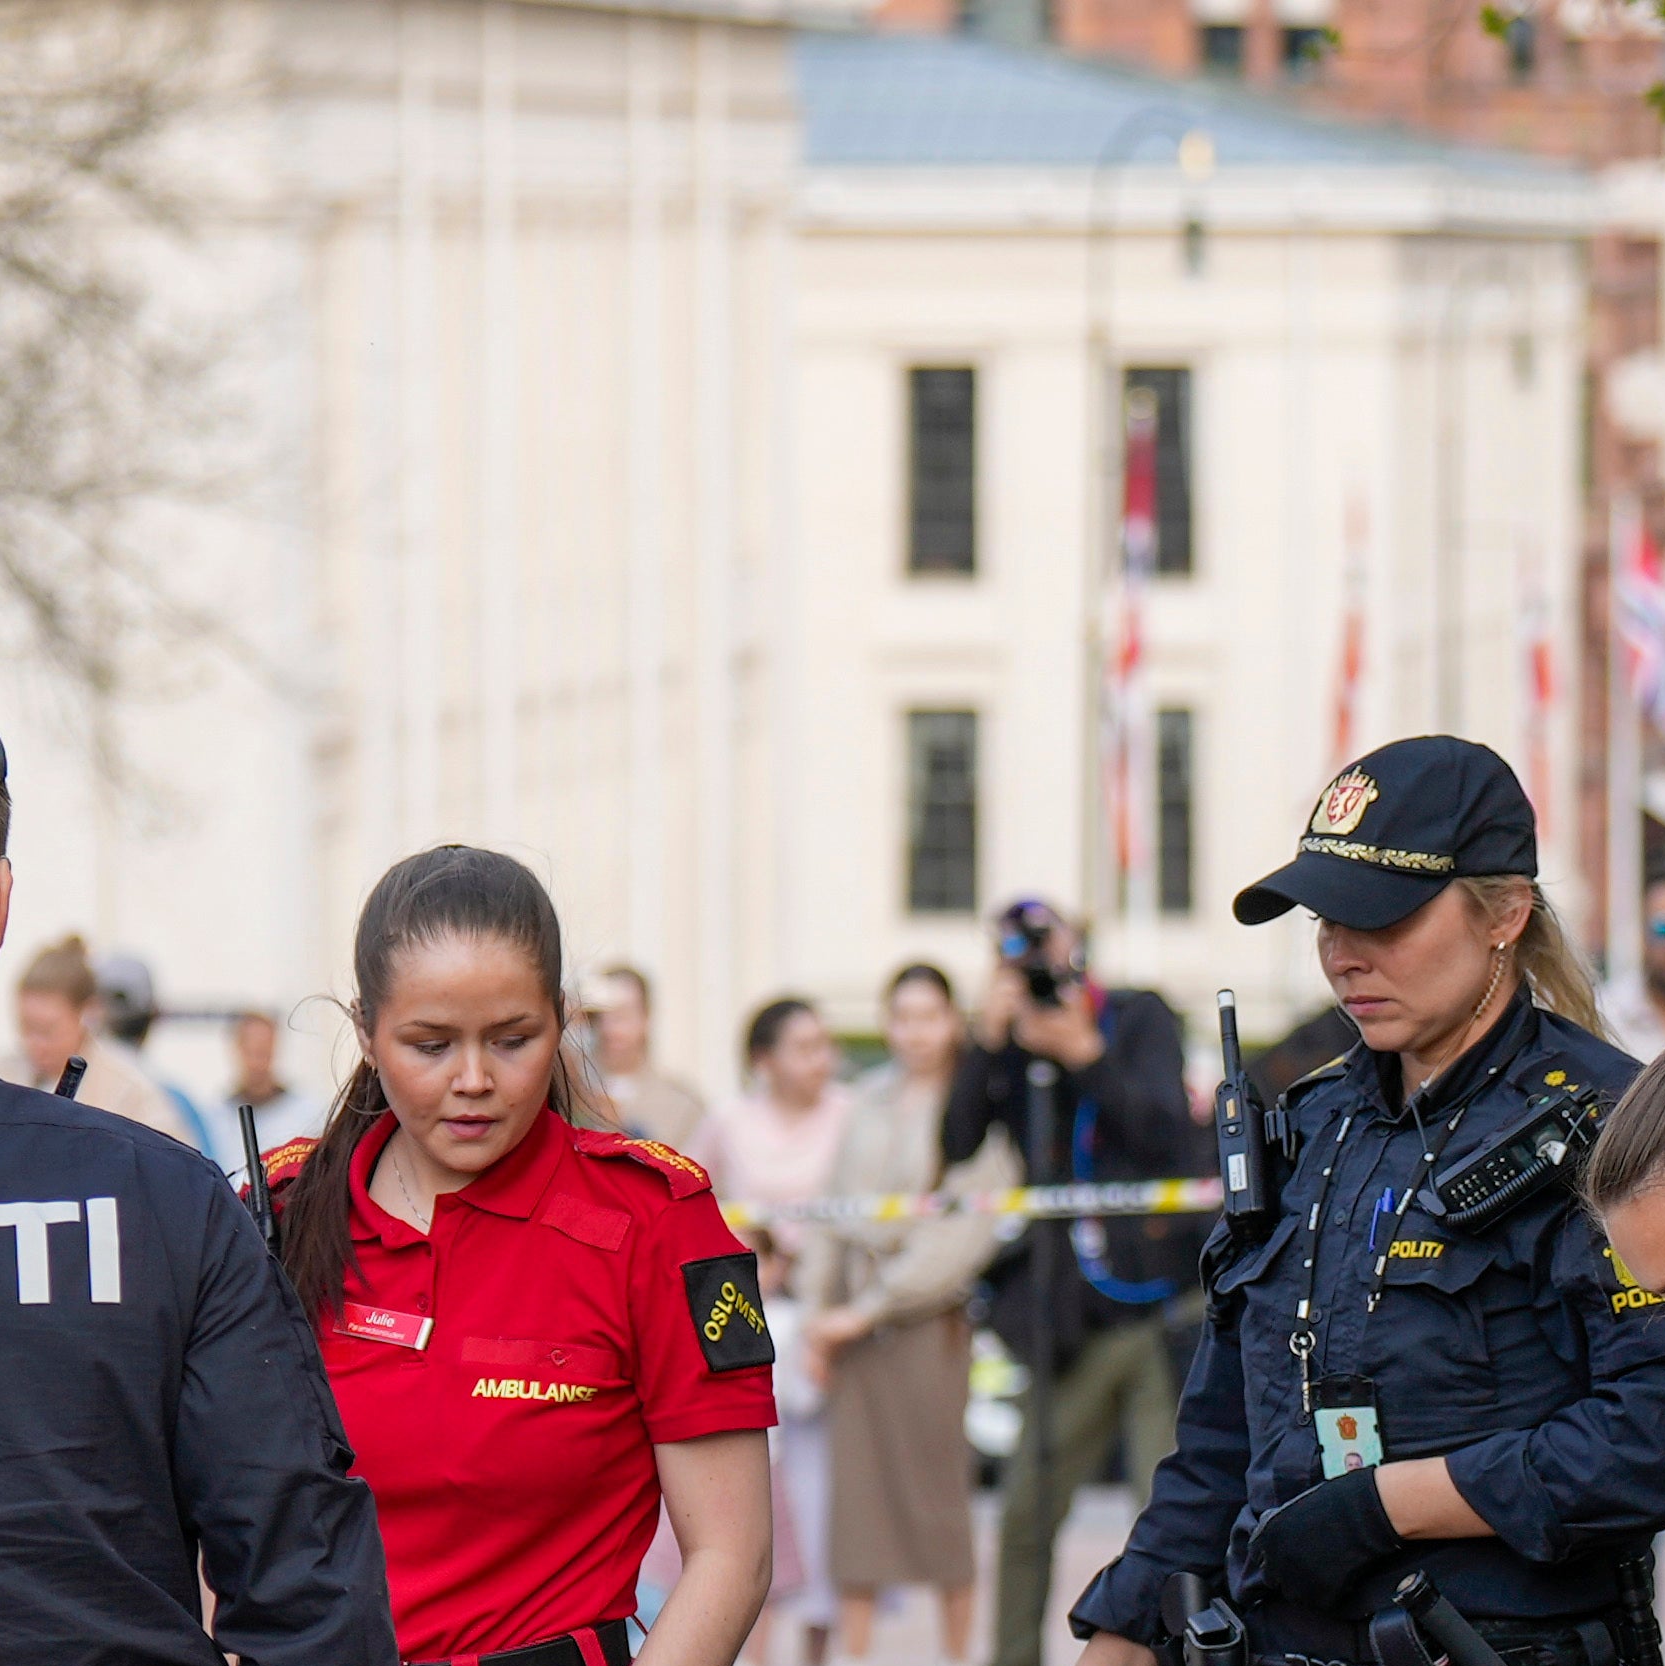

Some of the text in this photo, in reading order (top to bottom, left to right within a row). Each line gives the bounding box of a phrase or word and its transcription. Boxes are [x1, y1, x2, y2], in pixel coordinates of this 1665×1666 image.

[1388, 1240, 1445, 1259] POLITI
[365, 1311, 396, 1328] Julie
[471, 1378, 599, 1402] AMBULANSE
